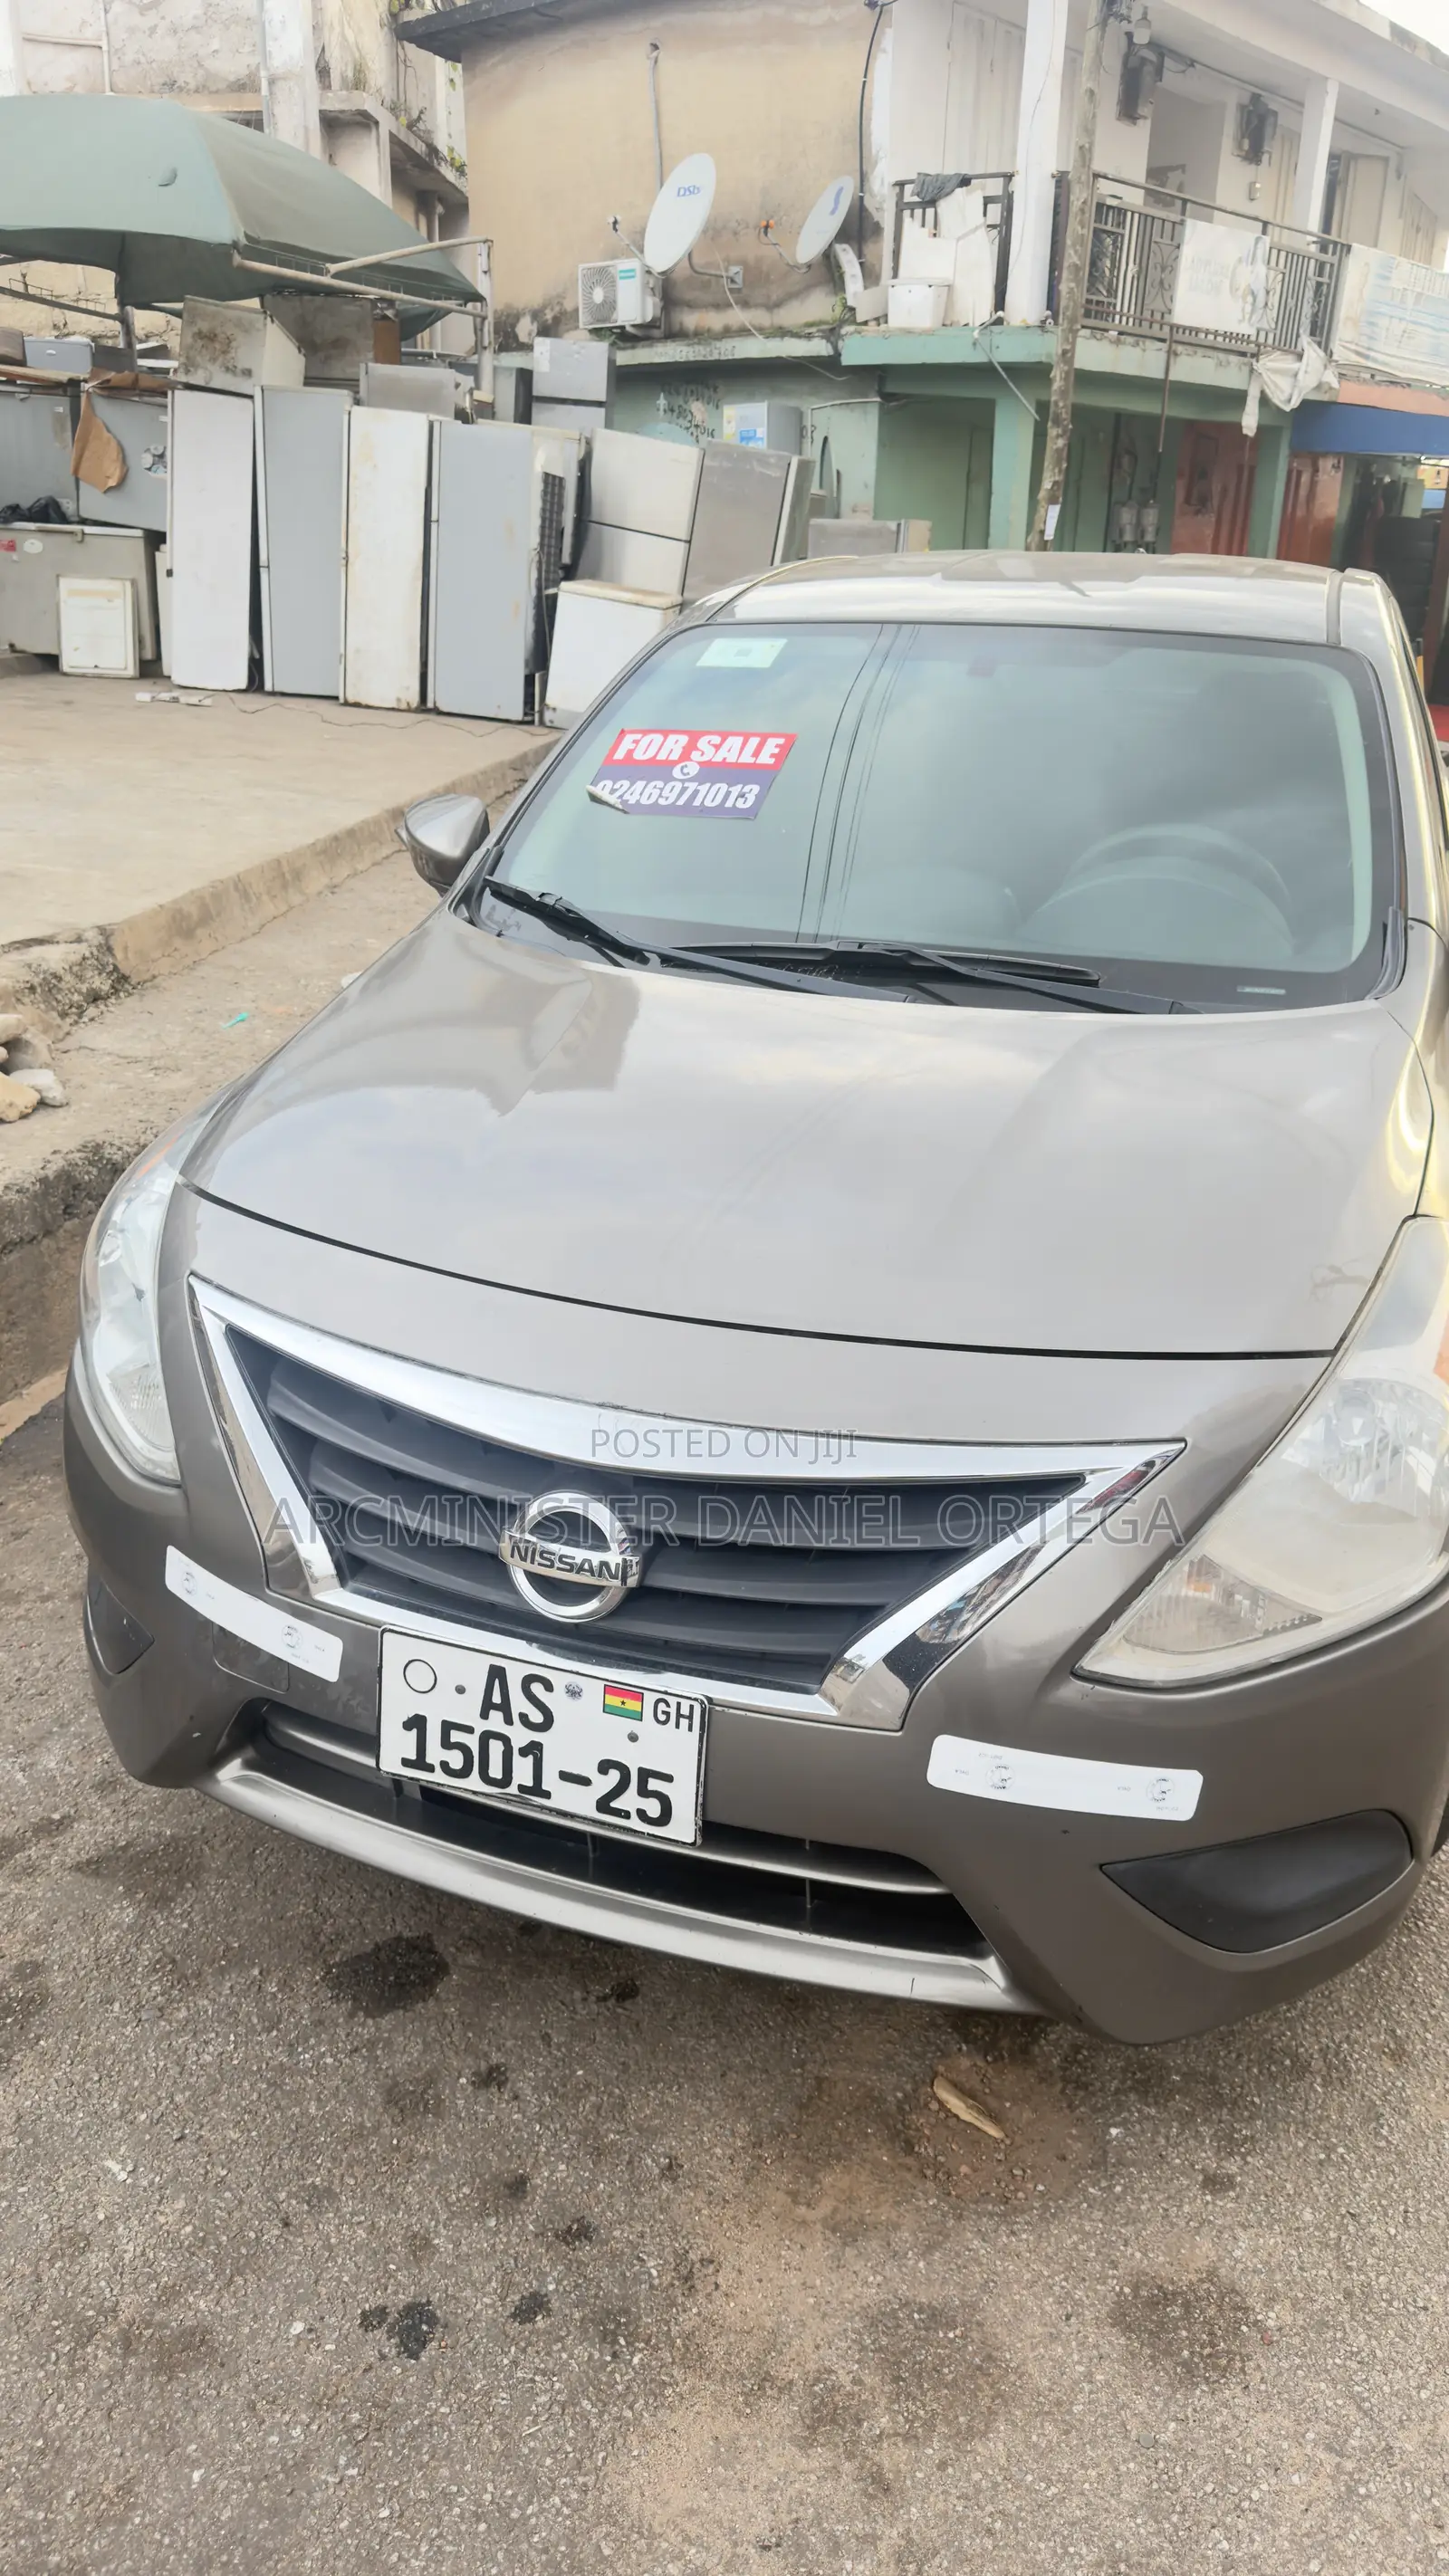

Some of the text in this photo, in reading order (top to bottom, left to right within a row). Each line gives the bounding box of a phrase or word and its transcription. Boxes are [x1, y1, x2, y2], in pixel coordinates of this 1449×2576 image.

[612, 733, 785, 764] FOR SALE
[510, 1540, 621, 1582] NISSAN
[479, 1663, 555, 1733] AS
[652, 1697, 695, 1733] GH
[400, 1712, 675, 1827] 1501-25
